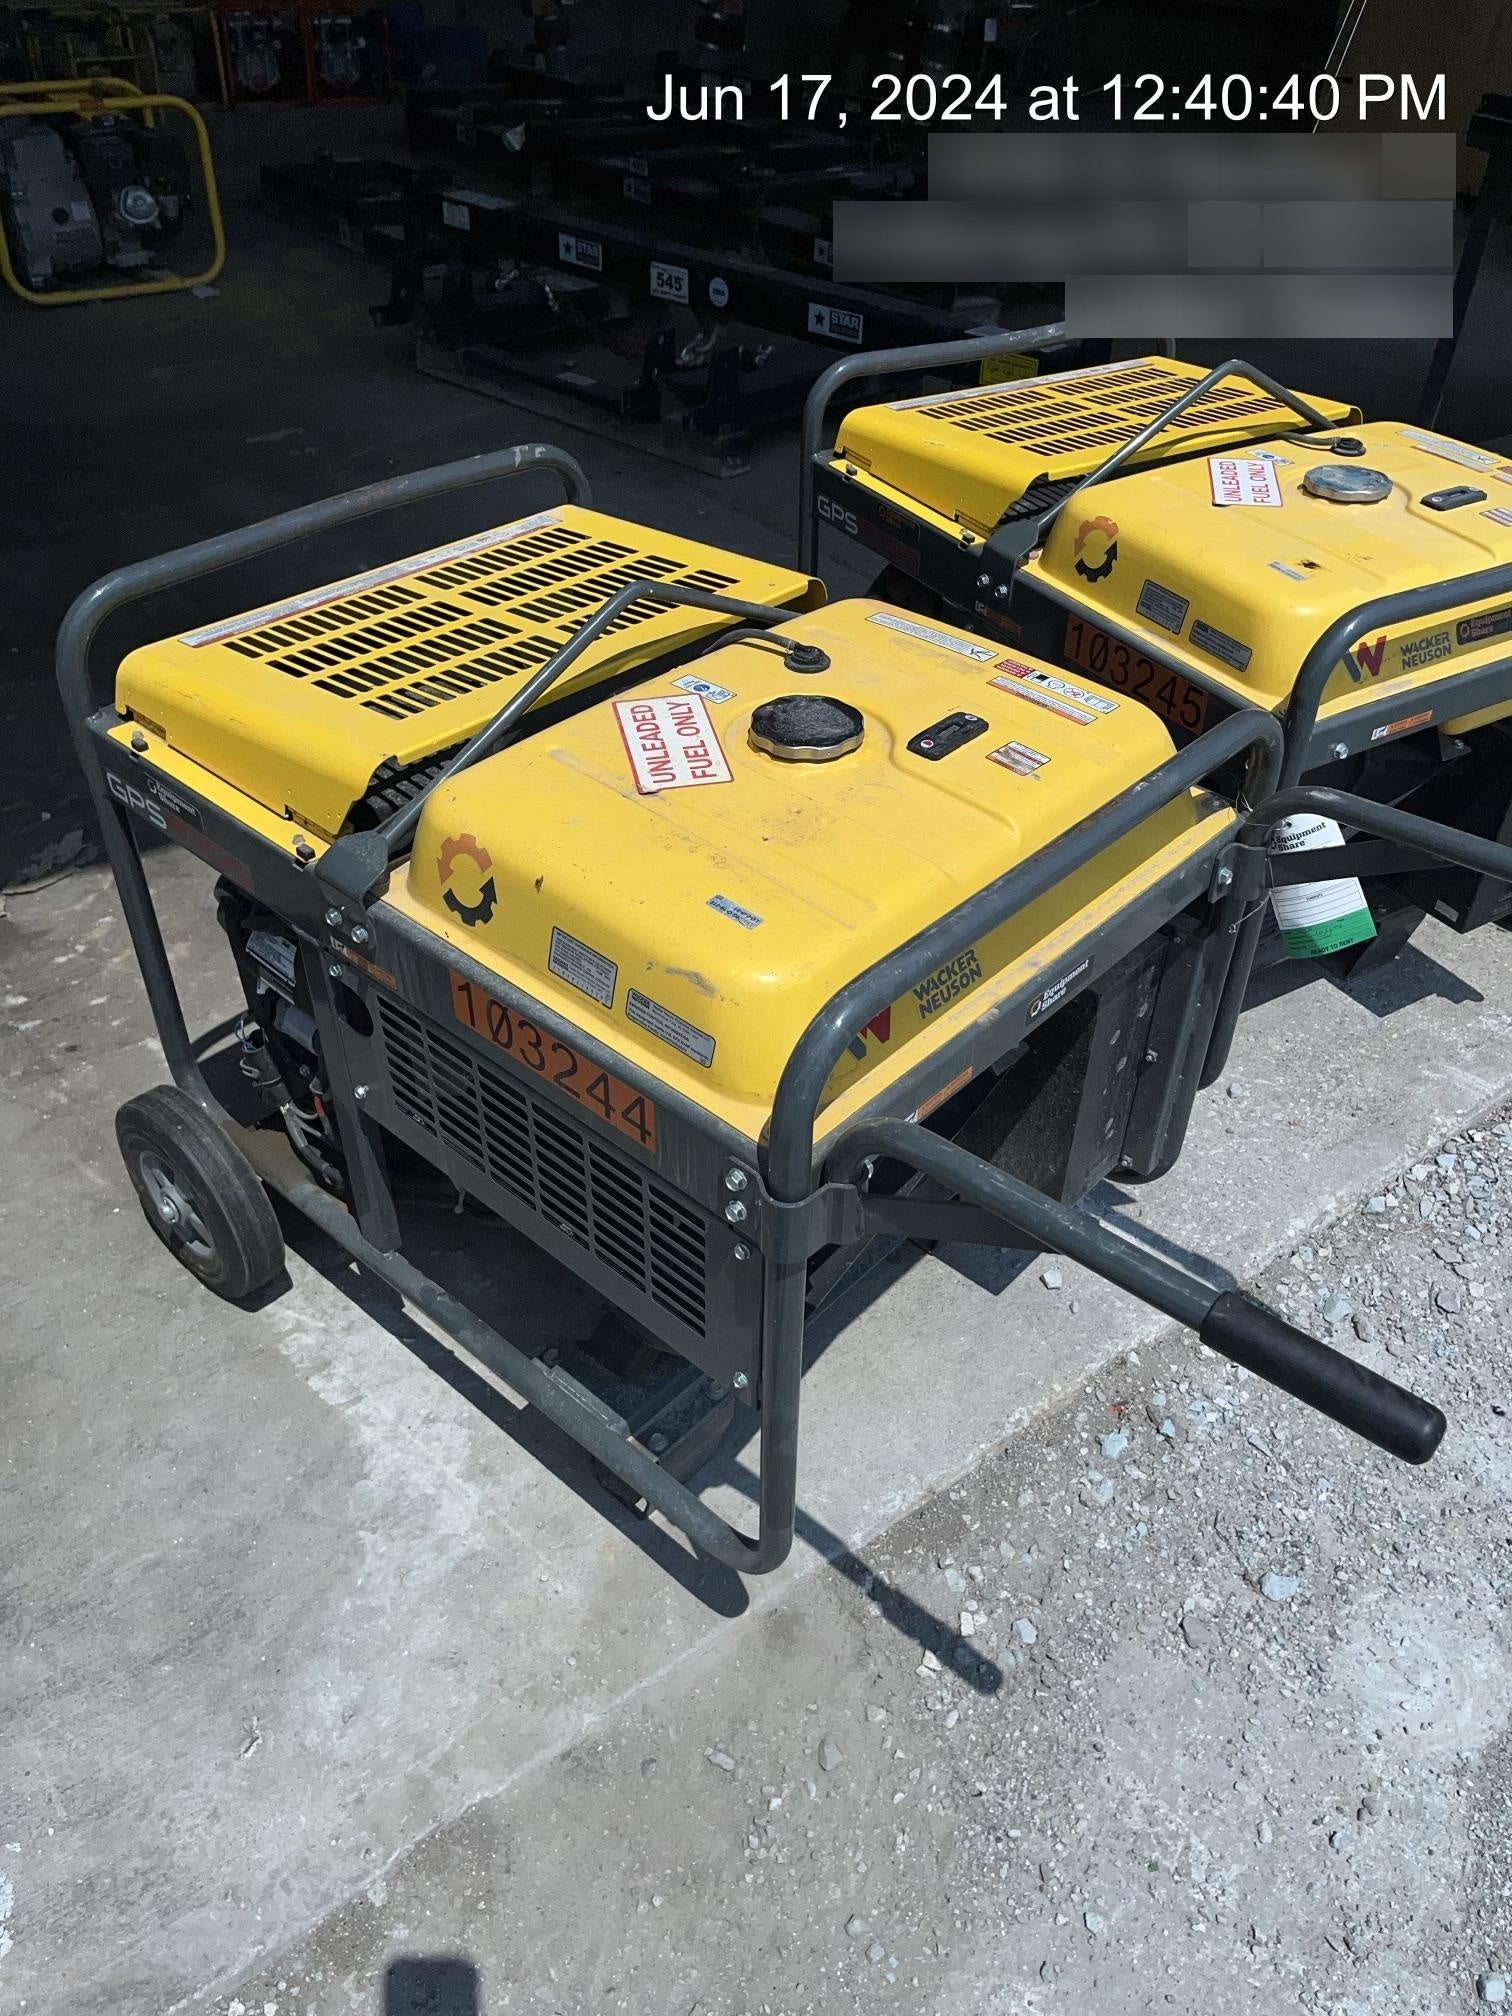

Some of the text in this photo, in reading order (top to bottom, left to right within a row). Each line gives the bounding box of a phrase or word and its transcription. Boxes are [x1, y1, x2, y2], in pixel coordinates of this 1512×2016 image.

[656, 272, 683, 292] 545
[830, 310, 860, 330] STAR
[1218, 460, 1243, 502] UNLEADED
[1247, 461, 1267, 482] ONLY
[1251, 483, 1272, 504] FUEL
[817, 494, 858, 535] GPS
[1400, 631, 1451, 657] WACKER
[1402, 643, 1452, 671] NEUSON
[1071, 622, 1206, 731] 103245
[666, 701, 701, 737] ONLY
[629, 704, 677, 784] UNLEADED
[682, 739, 718, 780] FUEL
[106, 771, 168, 830] GPS
[1275, 821, 1327, 845] Equipment
[1278, 839, 1306, 852] Share
[1339, 937, 1354, 947] RENT
[912, 948, 978, 1002] WACKER
[918, 962, 983, 1020] NEUSON
[1042, 959, 1090, 1001] Equipment
[1041, 986, 1067, 1011] Share
[457, 981, 653, 1145] 103244
